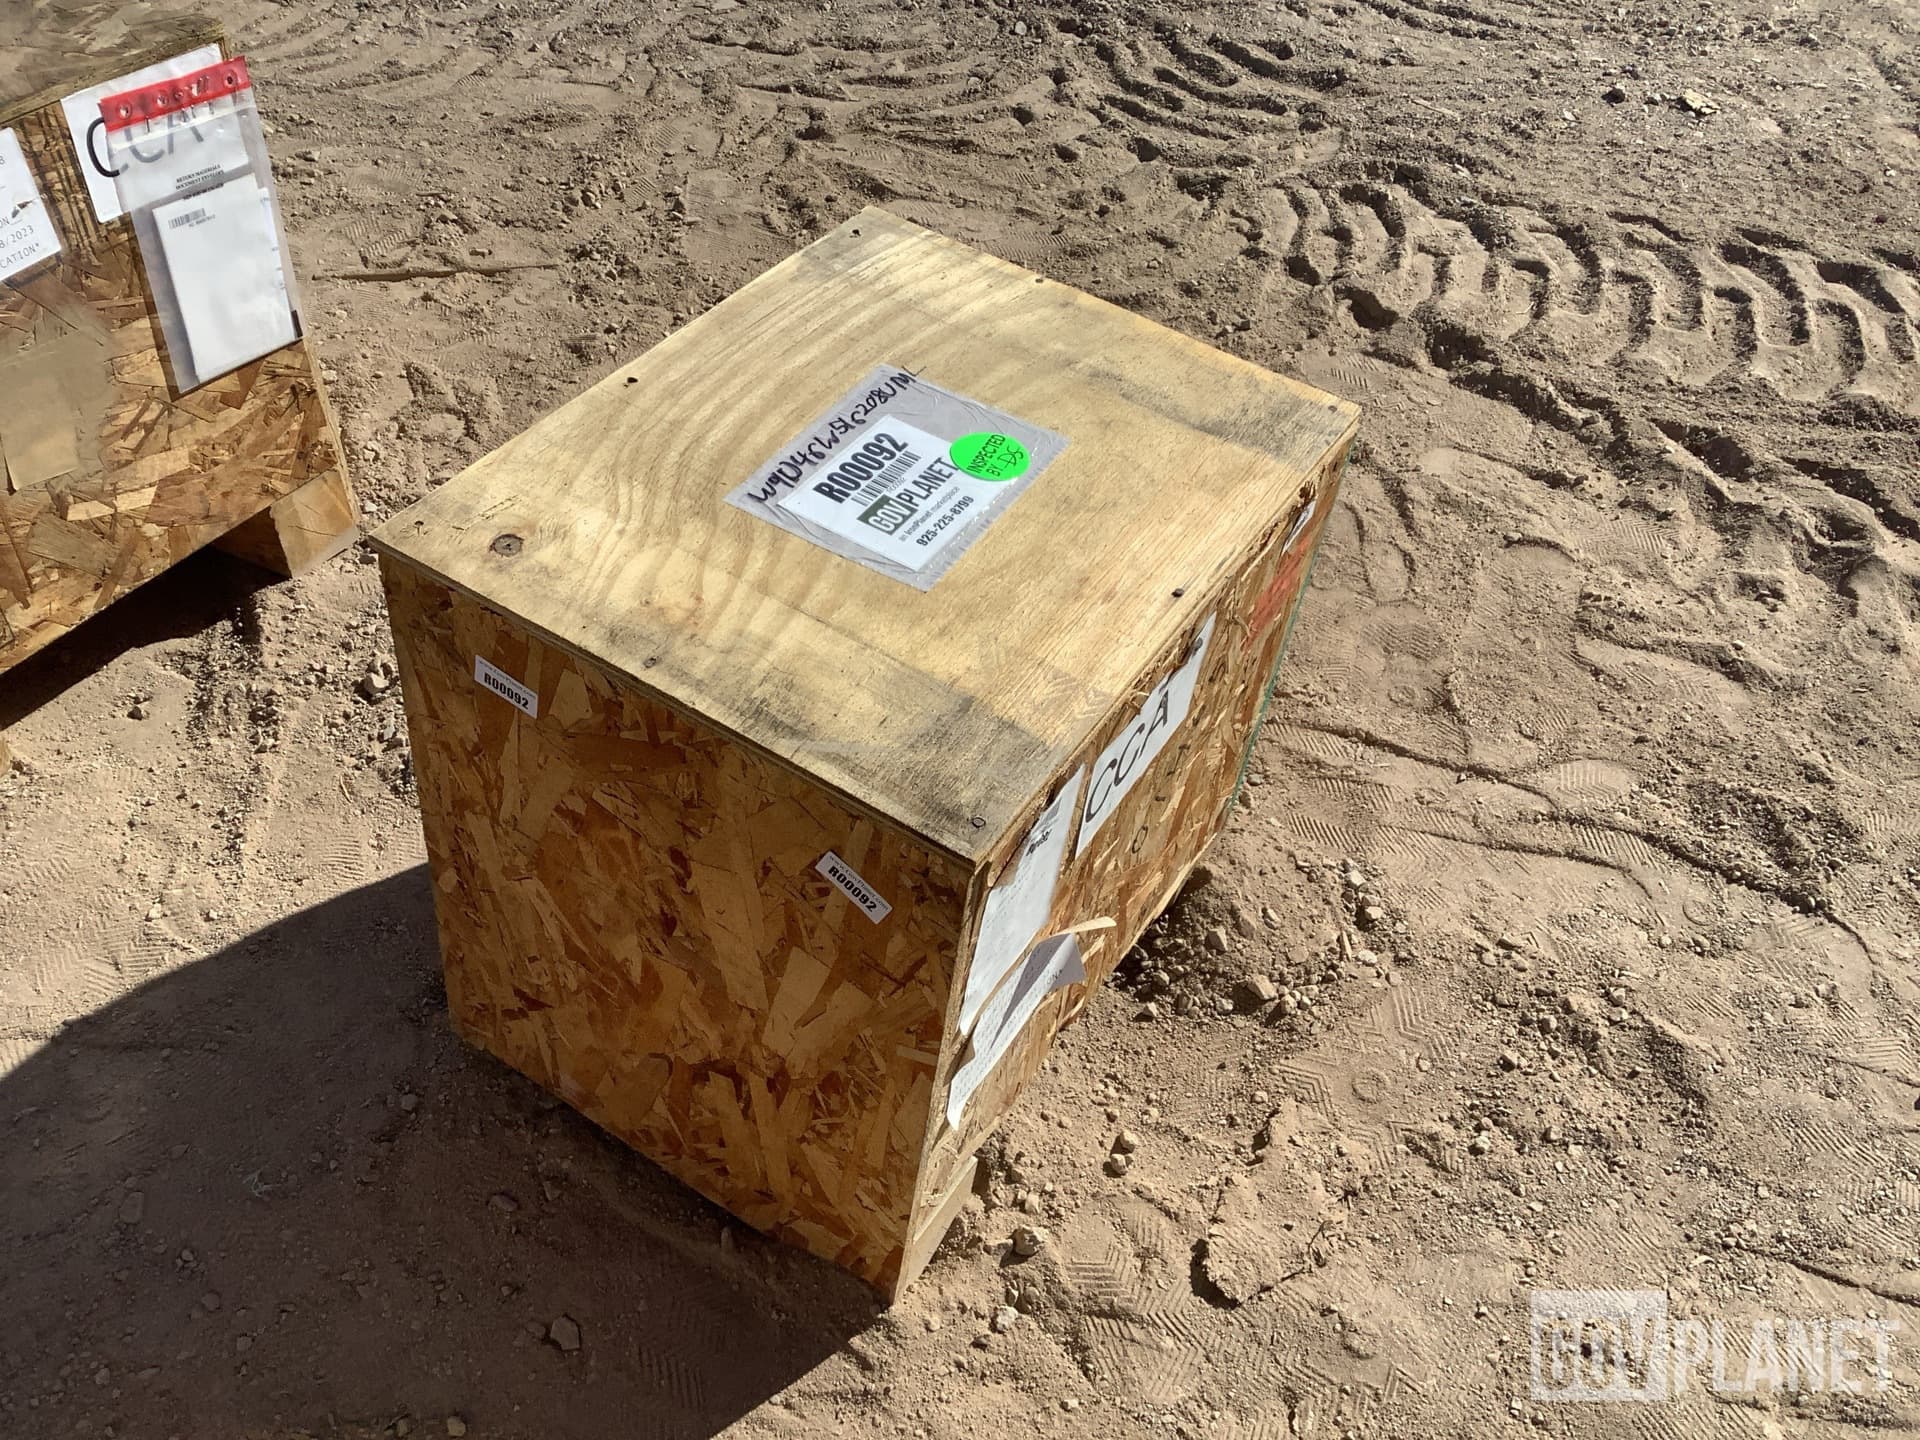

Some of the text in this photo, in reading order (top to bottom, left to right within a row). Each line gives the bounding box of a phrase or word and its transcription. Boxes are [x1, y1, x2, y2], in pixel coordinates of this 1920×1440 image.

[812, 432, 909, 504] R00092
[966, 433, 1006, 474] INSPECTED
[986, 464, 1001, 477] BY
[916, 495, 975, 547] 925-225-8799
[484, 672, 529, 710] R00092
[1085, 689, 1168, 823] CCA
[828, 865, 877, 912] R00092
